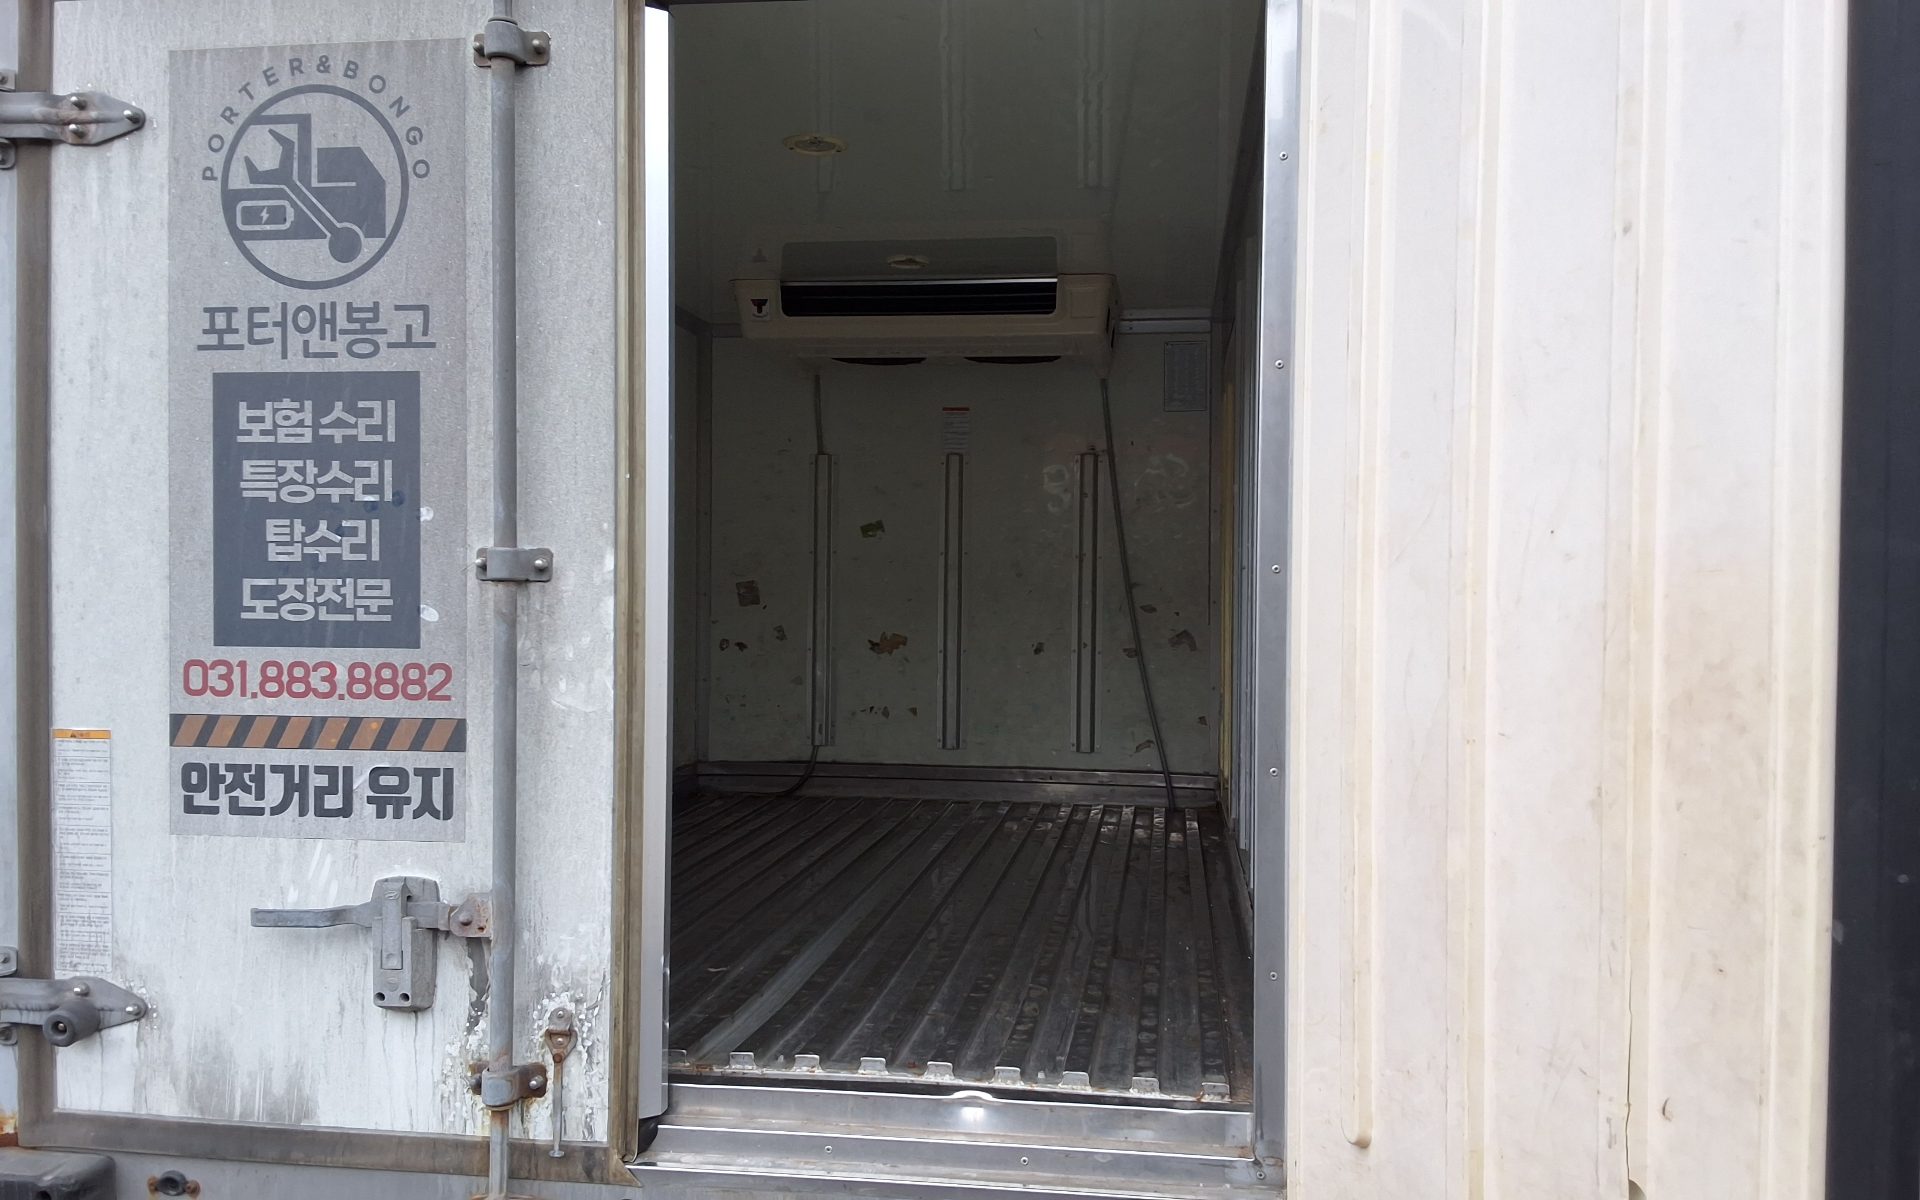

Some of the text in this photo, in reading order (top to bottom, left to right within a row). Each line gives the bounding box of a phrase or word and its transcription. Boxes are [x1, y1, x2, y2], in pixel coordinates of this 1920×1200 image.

[202, 55, 430, 181] PORTER&BONGO
[195, 301, 437, 359] 포터앤봉고
[239, 459, 393, 503] 특장수리
[265, 518, 380, 562] 탑수리
[240, 577, 394, 622] 도장전문
[183, 659, 453, 701] 031.883.8882
[180, 762, 455, 821] 안전거리 유지
